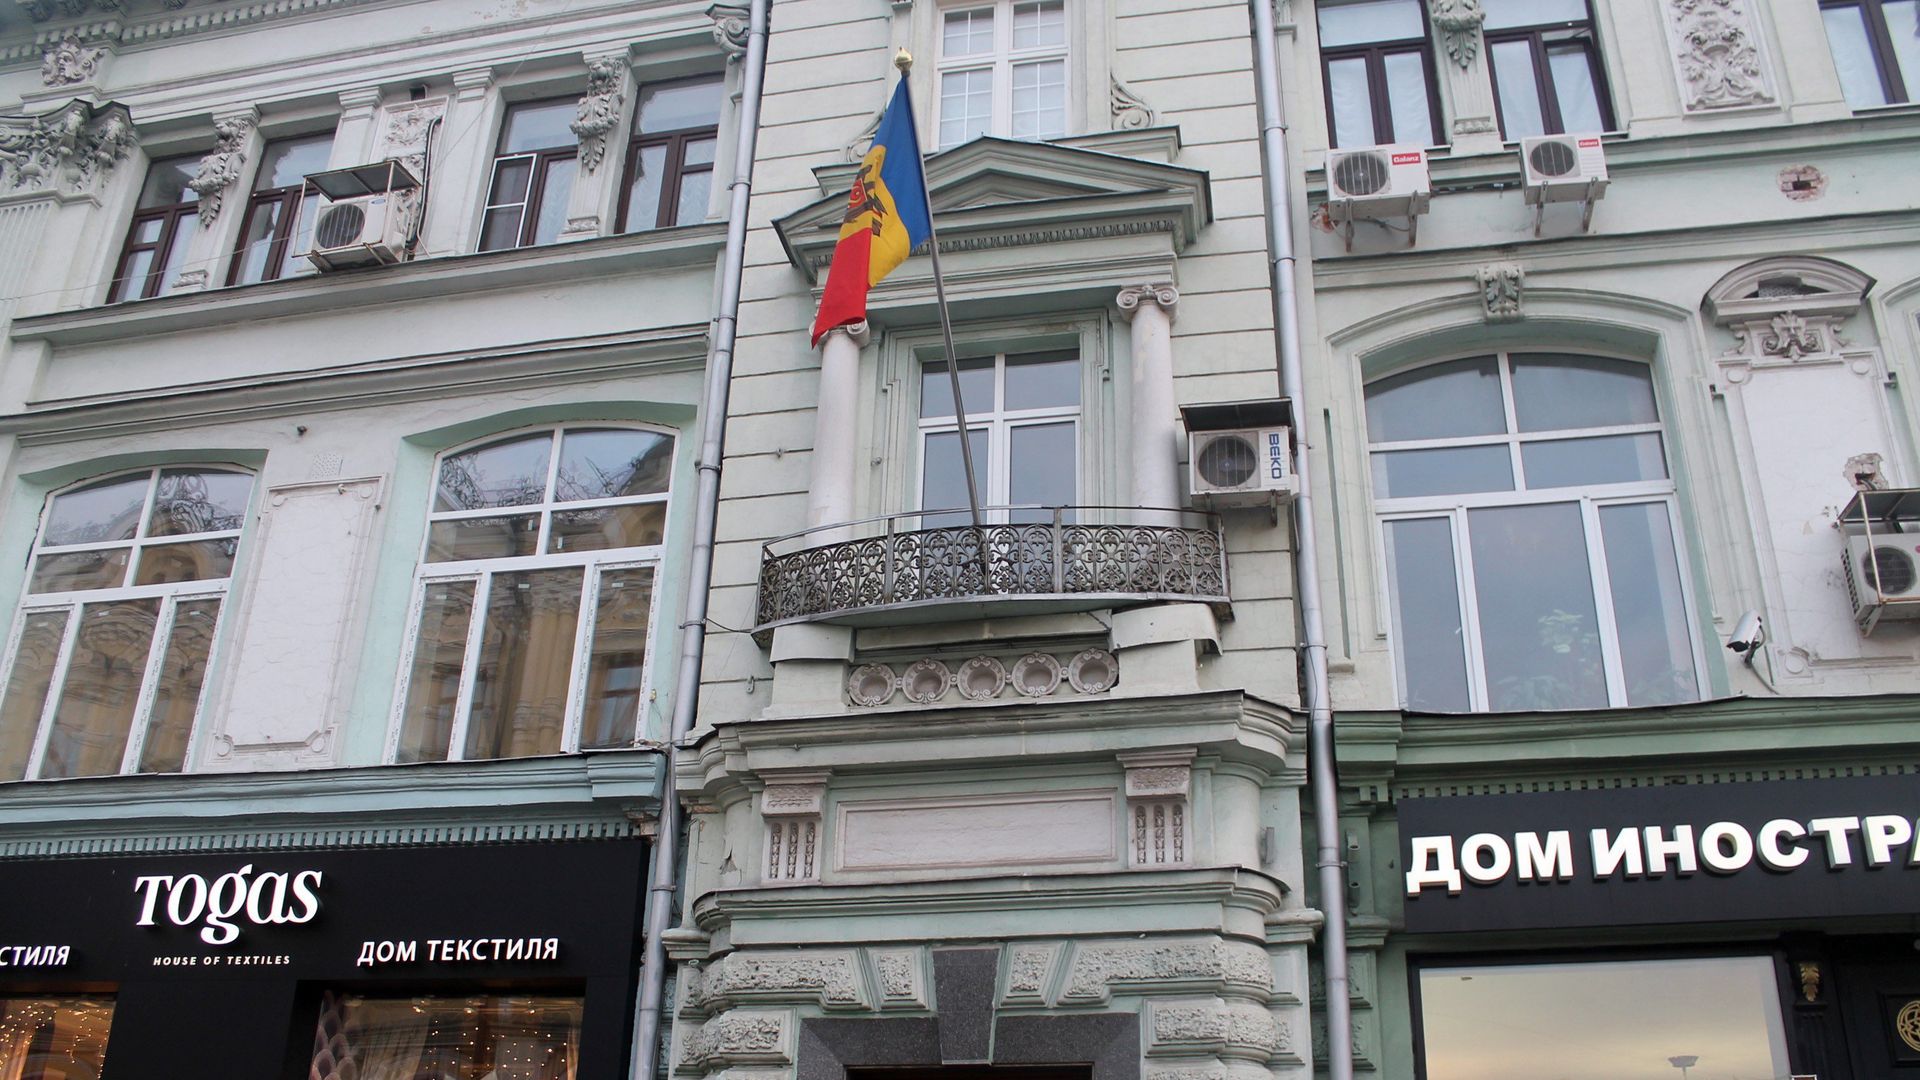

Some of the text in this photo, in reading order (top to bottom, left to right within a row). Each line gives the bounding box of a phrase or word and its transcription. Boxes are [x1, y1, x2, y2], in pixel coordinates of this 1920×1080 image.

[1393, 155, 1419, 163] Galanz
[1269, 433, 1282, 479] BEKO
[1406, 815, 1920, 896] ДОМ ИНОСТР
[153, 955, 291, 966] HOUSE OF TEXTILES
[356, 937, 559, 967] ДОМ ТЕКСТИЛЯ
